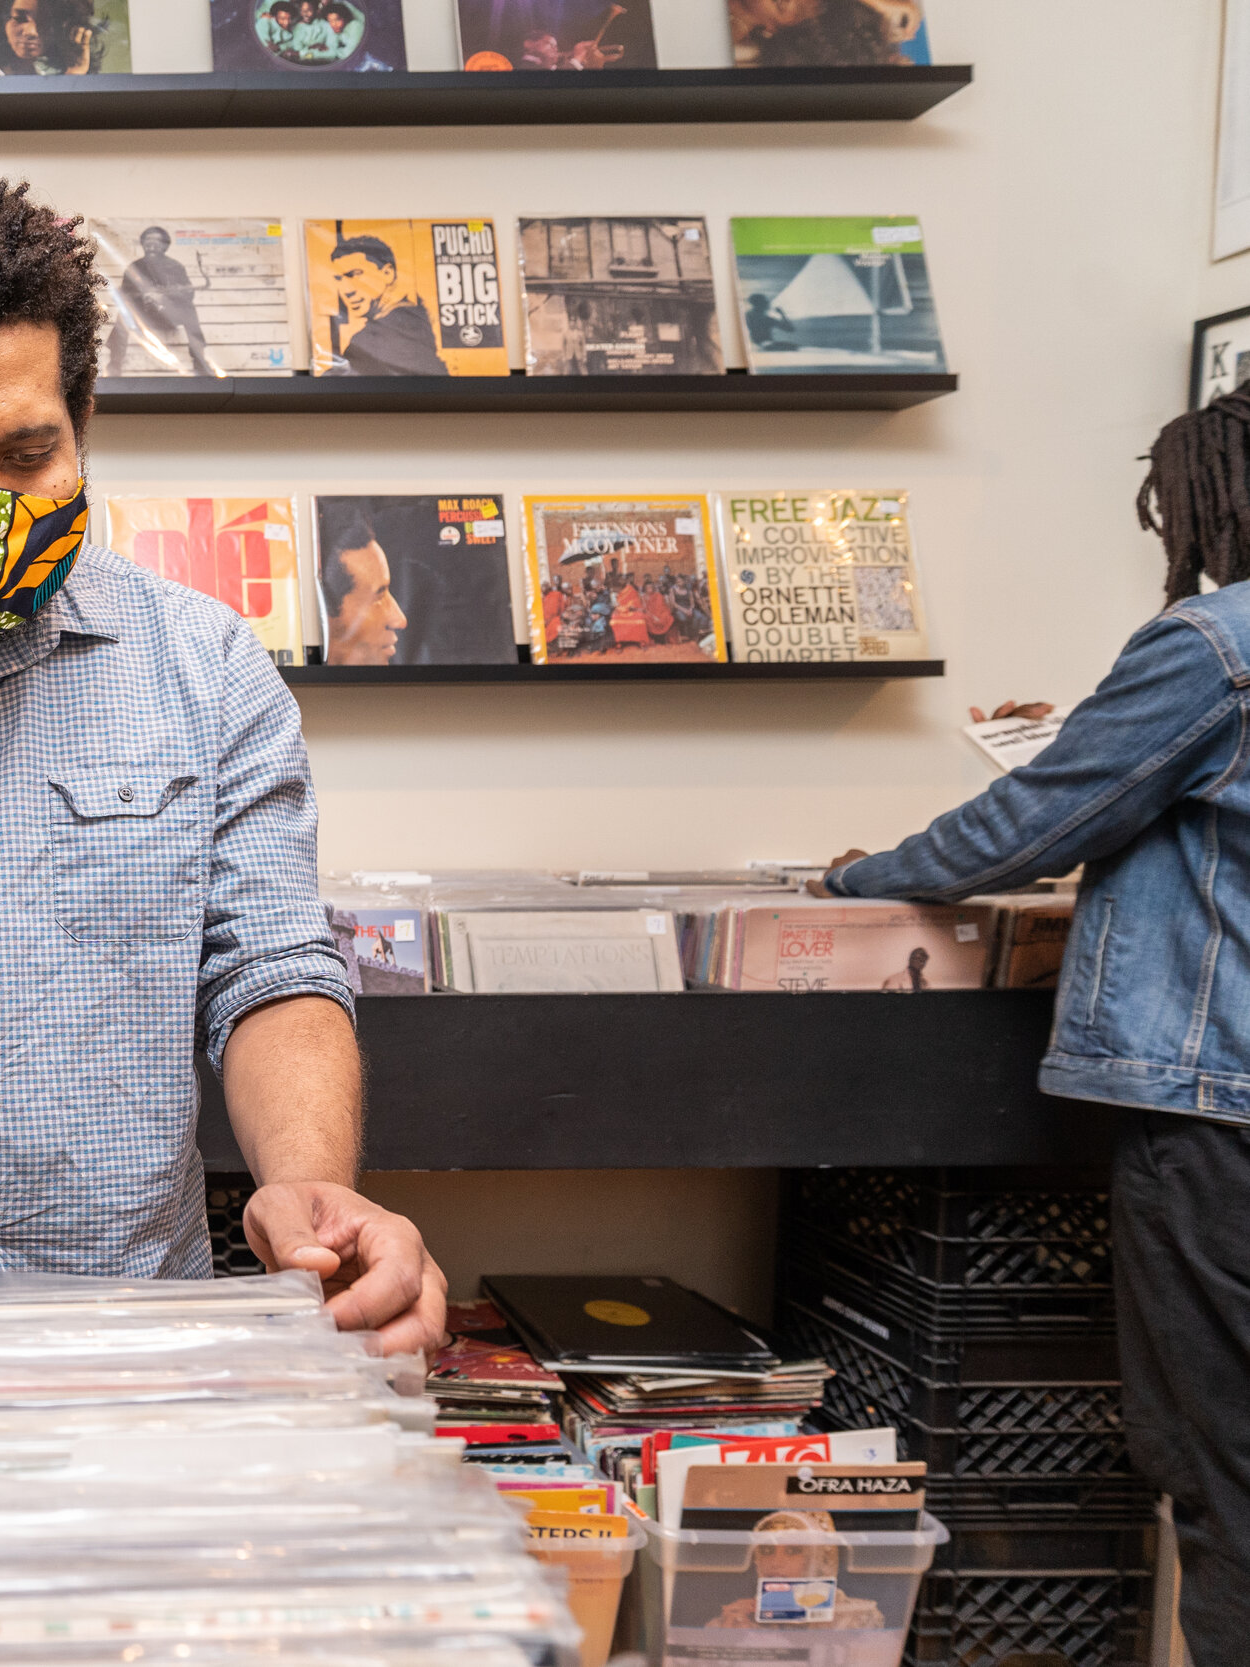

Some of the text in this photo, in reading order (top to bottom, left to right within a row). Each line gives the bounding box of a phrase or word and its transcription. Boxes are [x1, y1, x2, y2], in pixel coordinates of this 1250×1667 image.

[433, 225, 494, 256] PUCHO
[437, 264, 499, 305] BIG
[440, 304, 500, 327] STICK
[438, 499, 459, 511] MAX
[730, 499, 809, 523] FREE
[572, 521, 667, 537] EXTENSIONS
[622, 538, 679, 554] TYNER
[735, 545, 910, 565] IMPROVISATION
[766, 565, 850, 585] BY THE
[740, 586, 851, 606] ORNETTE
[742, 606, 856, 626] COLEMAN
[745, 626, 858, 647] DOUBLE
[747, 647, 858, 662] QUARTET
[353, 925, 379, 938] THE
[781, 930, 835, 940] PART-TIME
[490, 943, 650, 967] TEMPTATIONS
[780, 941, 834, 957] LOVER
[778, 978, 829, 991] STEVIE
[800, 1478, 912, 1492] OFRA HAZA
